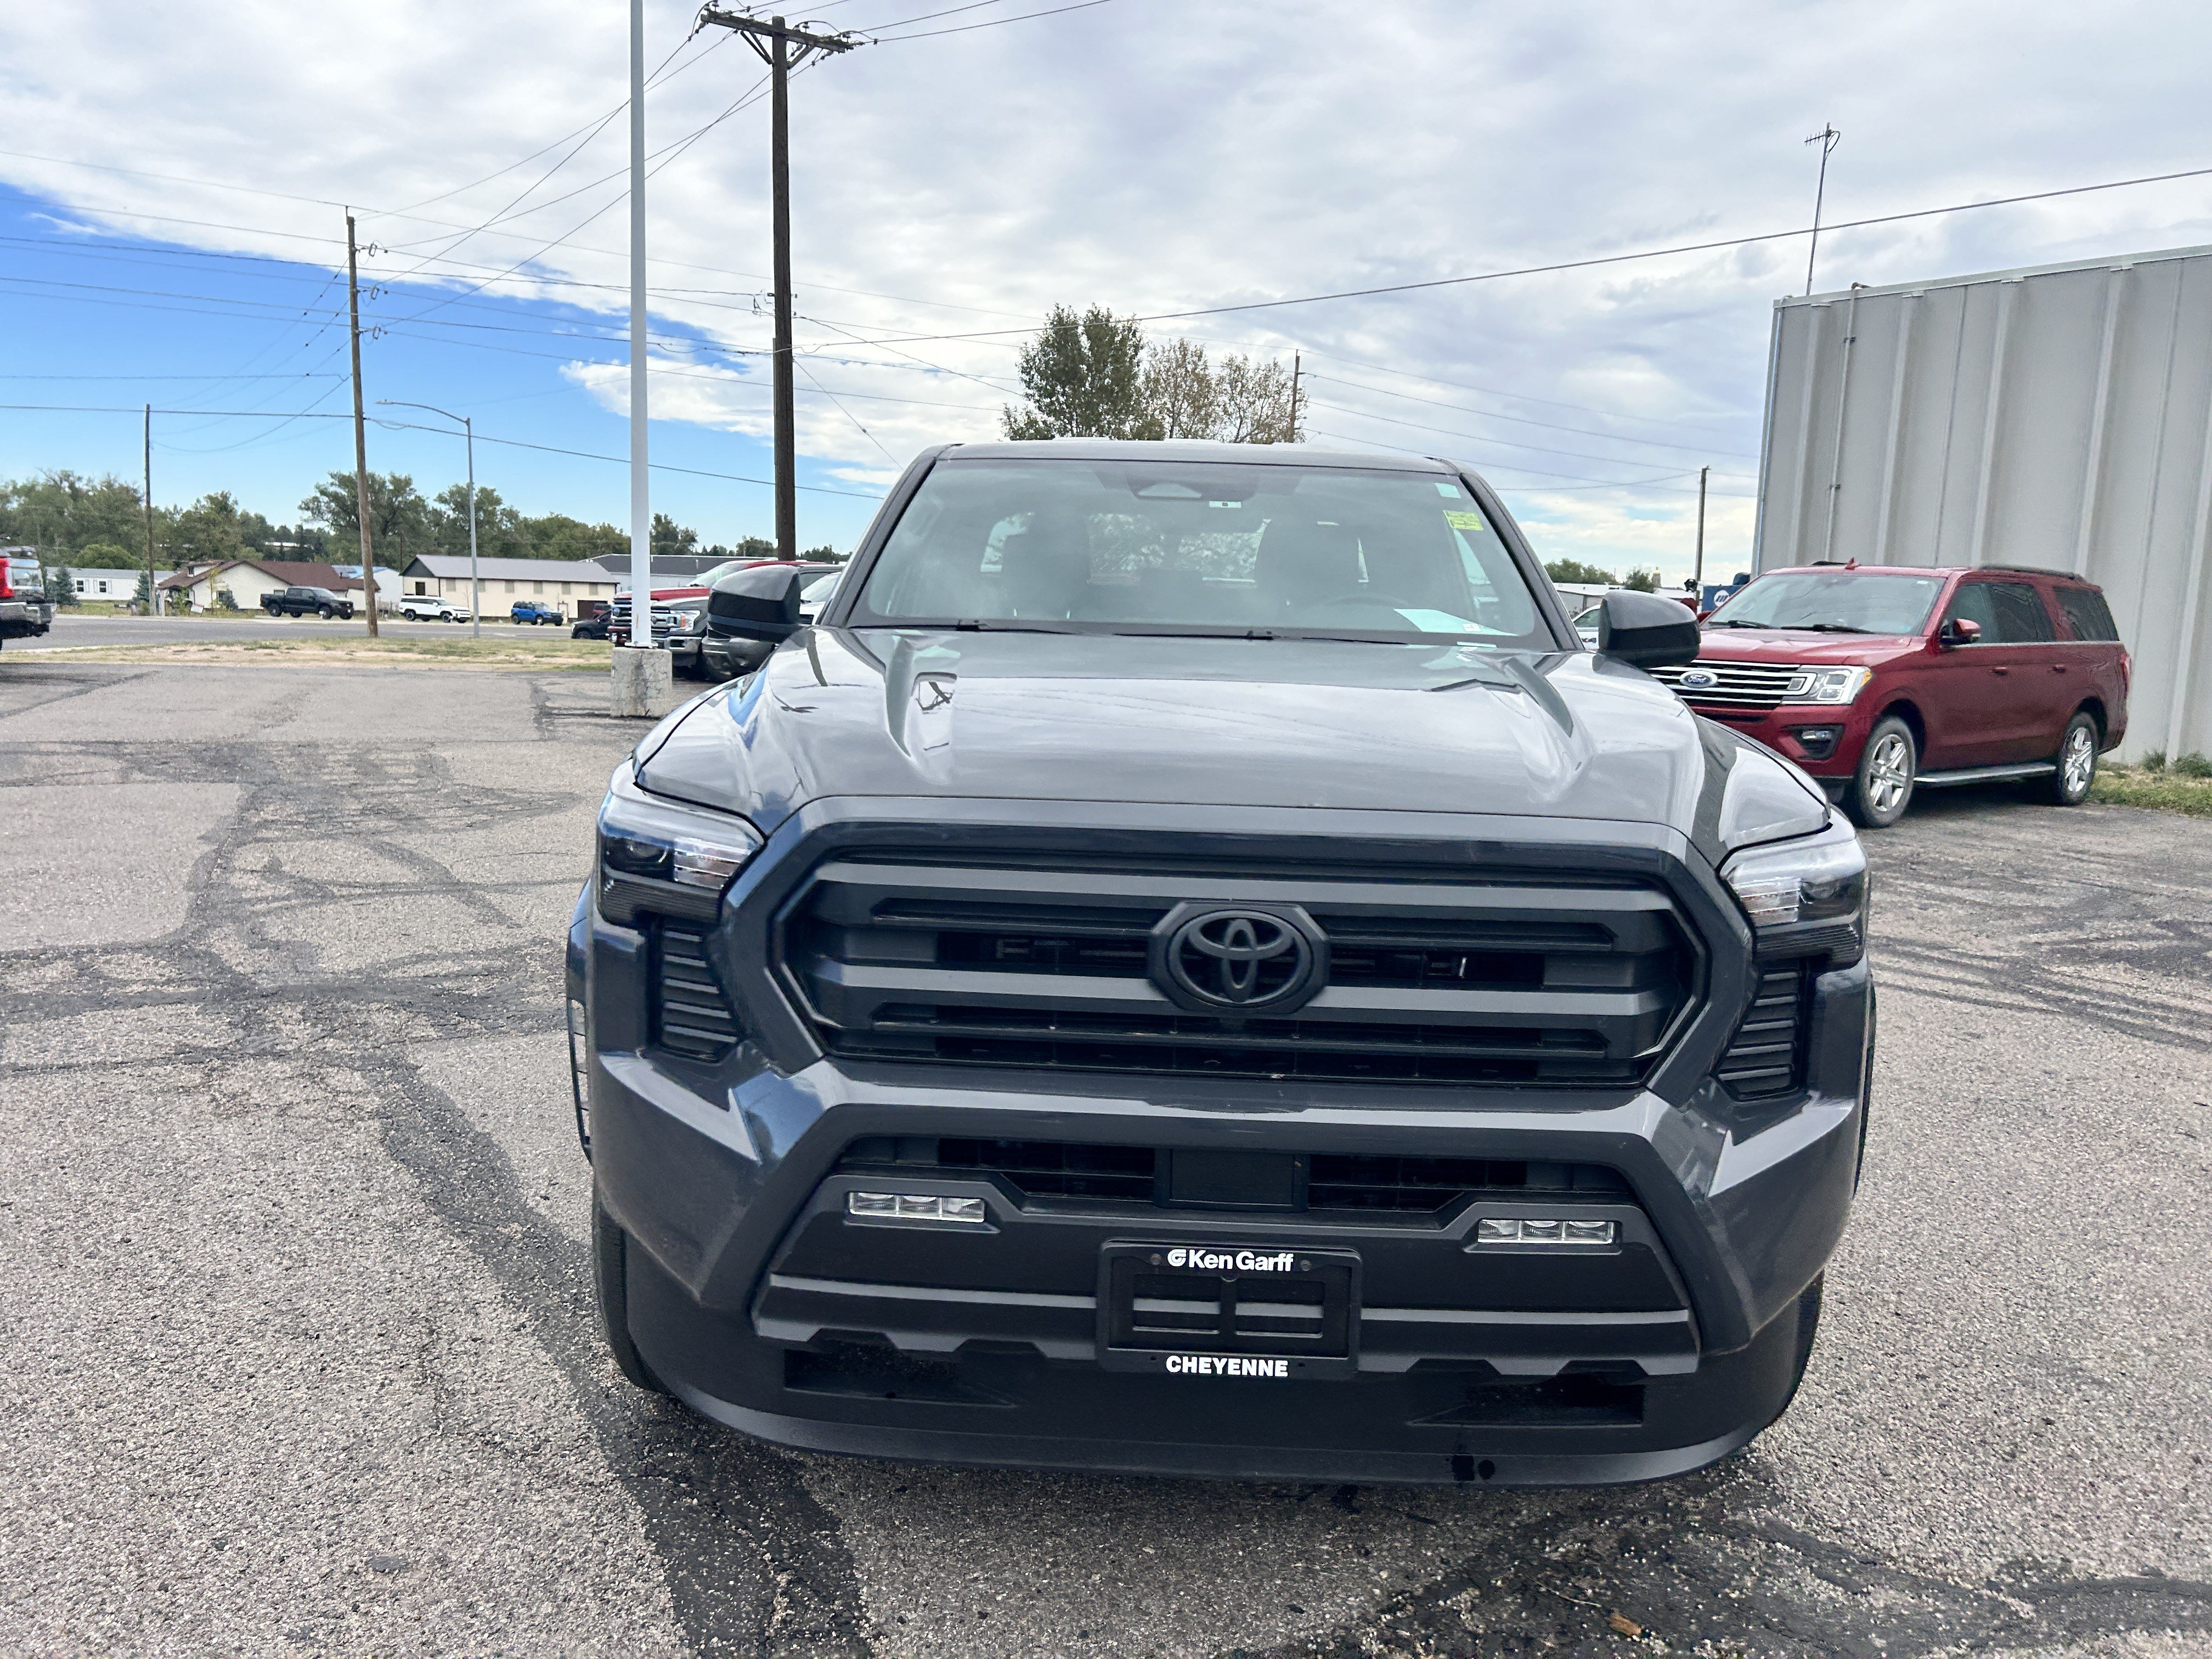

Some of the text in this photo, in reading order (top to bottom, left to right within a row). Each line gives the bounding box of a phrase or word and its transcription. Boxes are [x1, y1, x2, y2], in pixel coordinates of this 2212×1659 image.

[1688, 674, 1707, 683] Ford
[1188, 1249, 1294, 1272] Ken Garff
[1166, 1355, 1289, 1377] CHEYENNE
